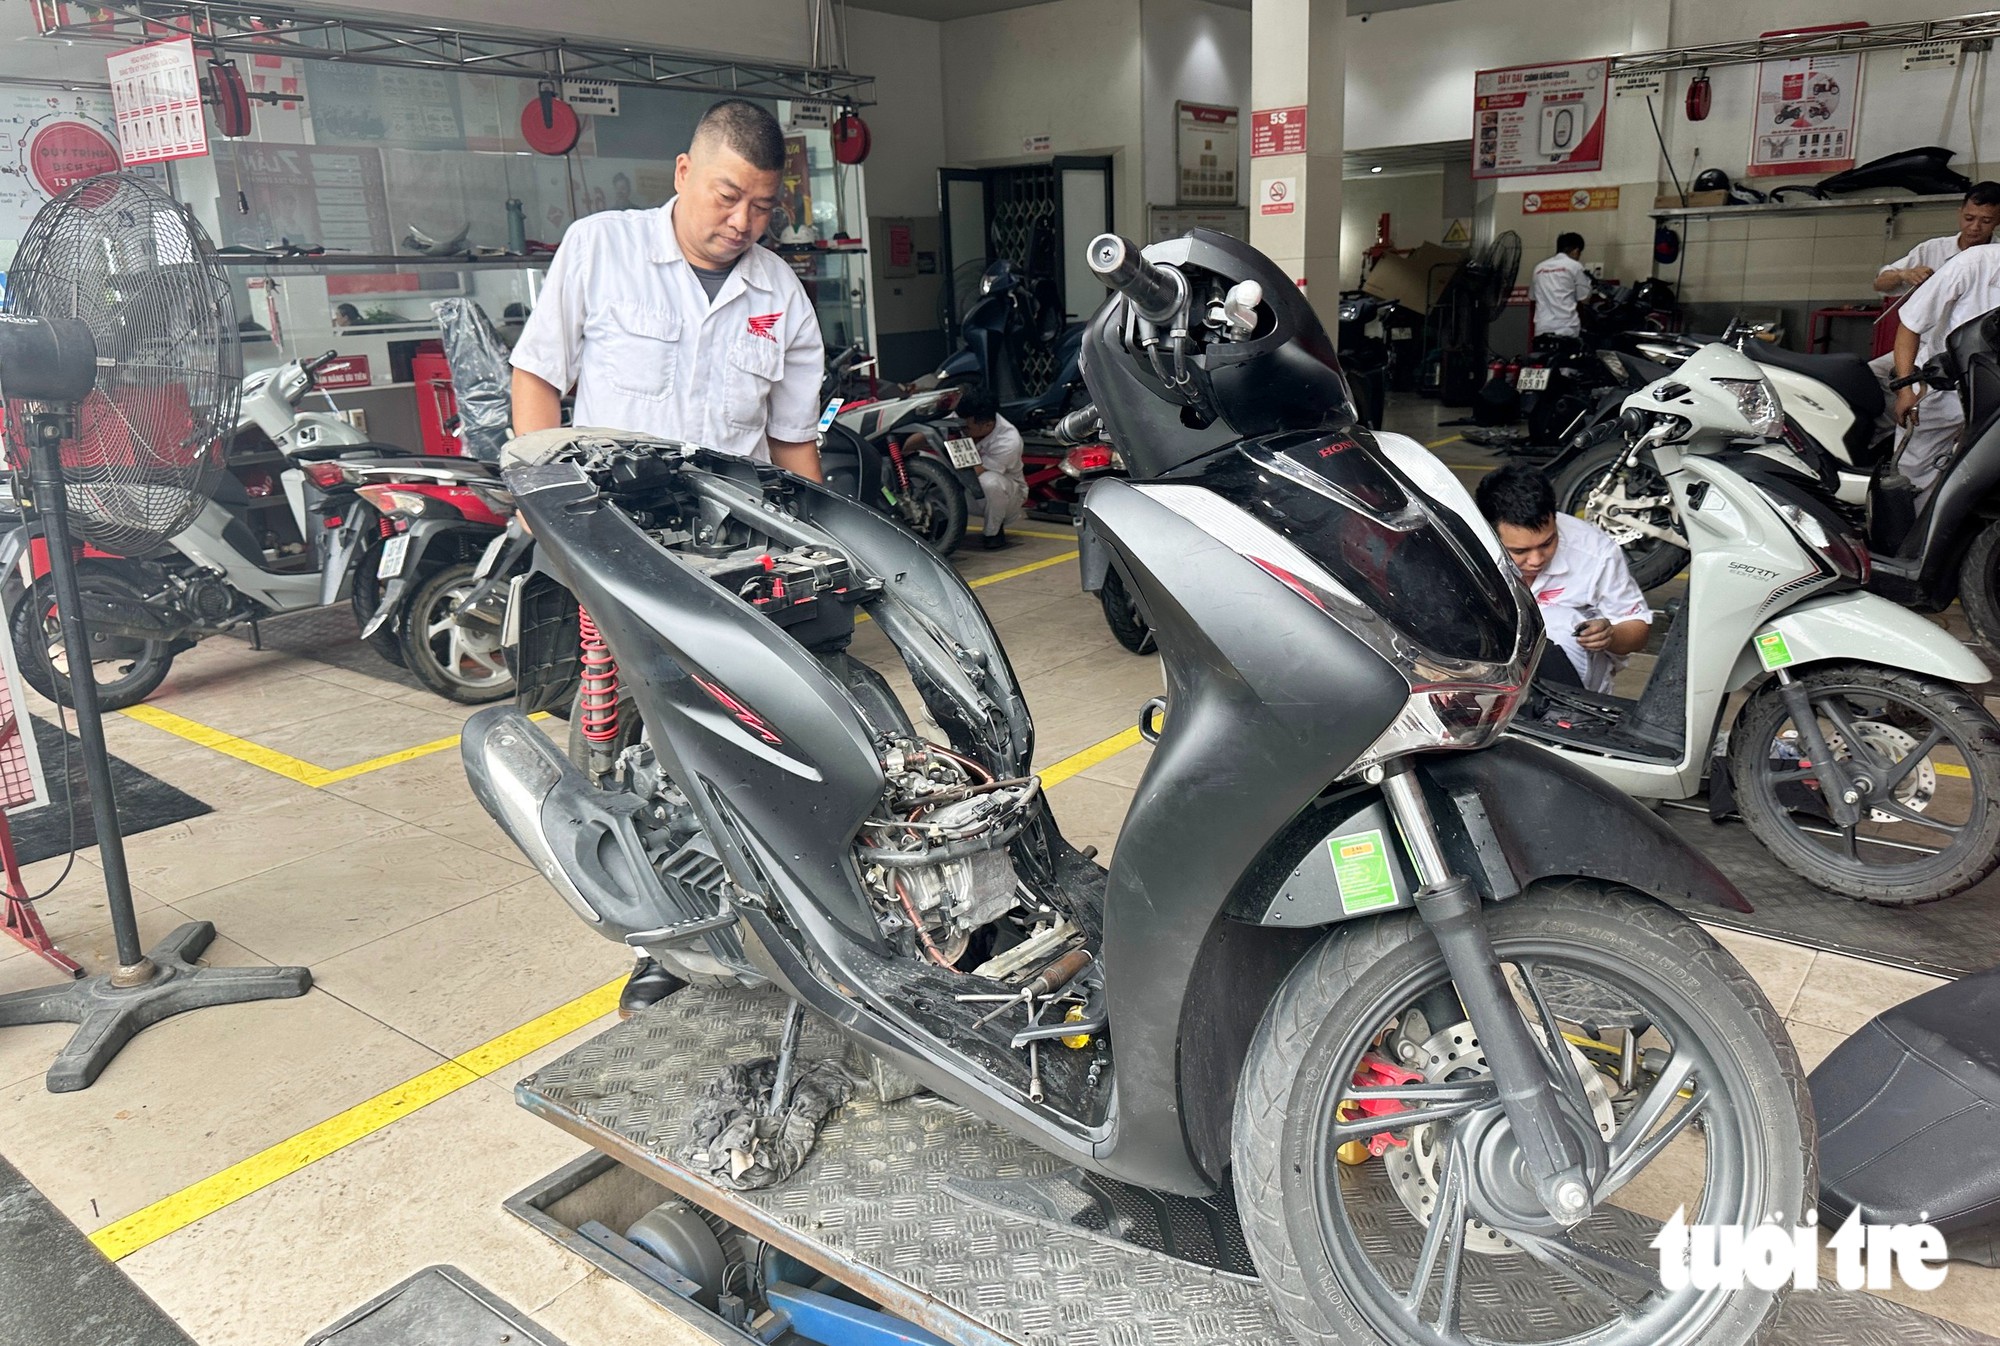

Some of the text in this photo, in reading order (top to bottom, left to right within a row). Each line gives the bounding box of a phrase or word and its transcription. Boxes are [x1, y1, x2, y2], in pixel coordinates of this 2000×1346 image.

[1270, 111, 1287, 125] 5S
[54, 177, 69, 188] 13
[747, 327, 778, 344] HONDA
[1728, 561, 1780, 579] SPORTY
